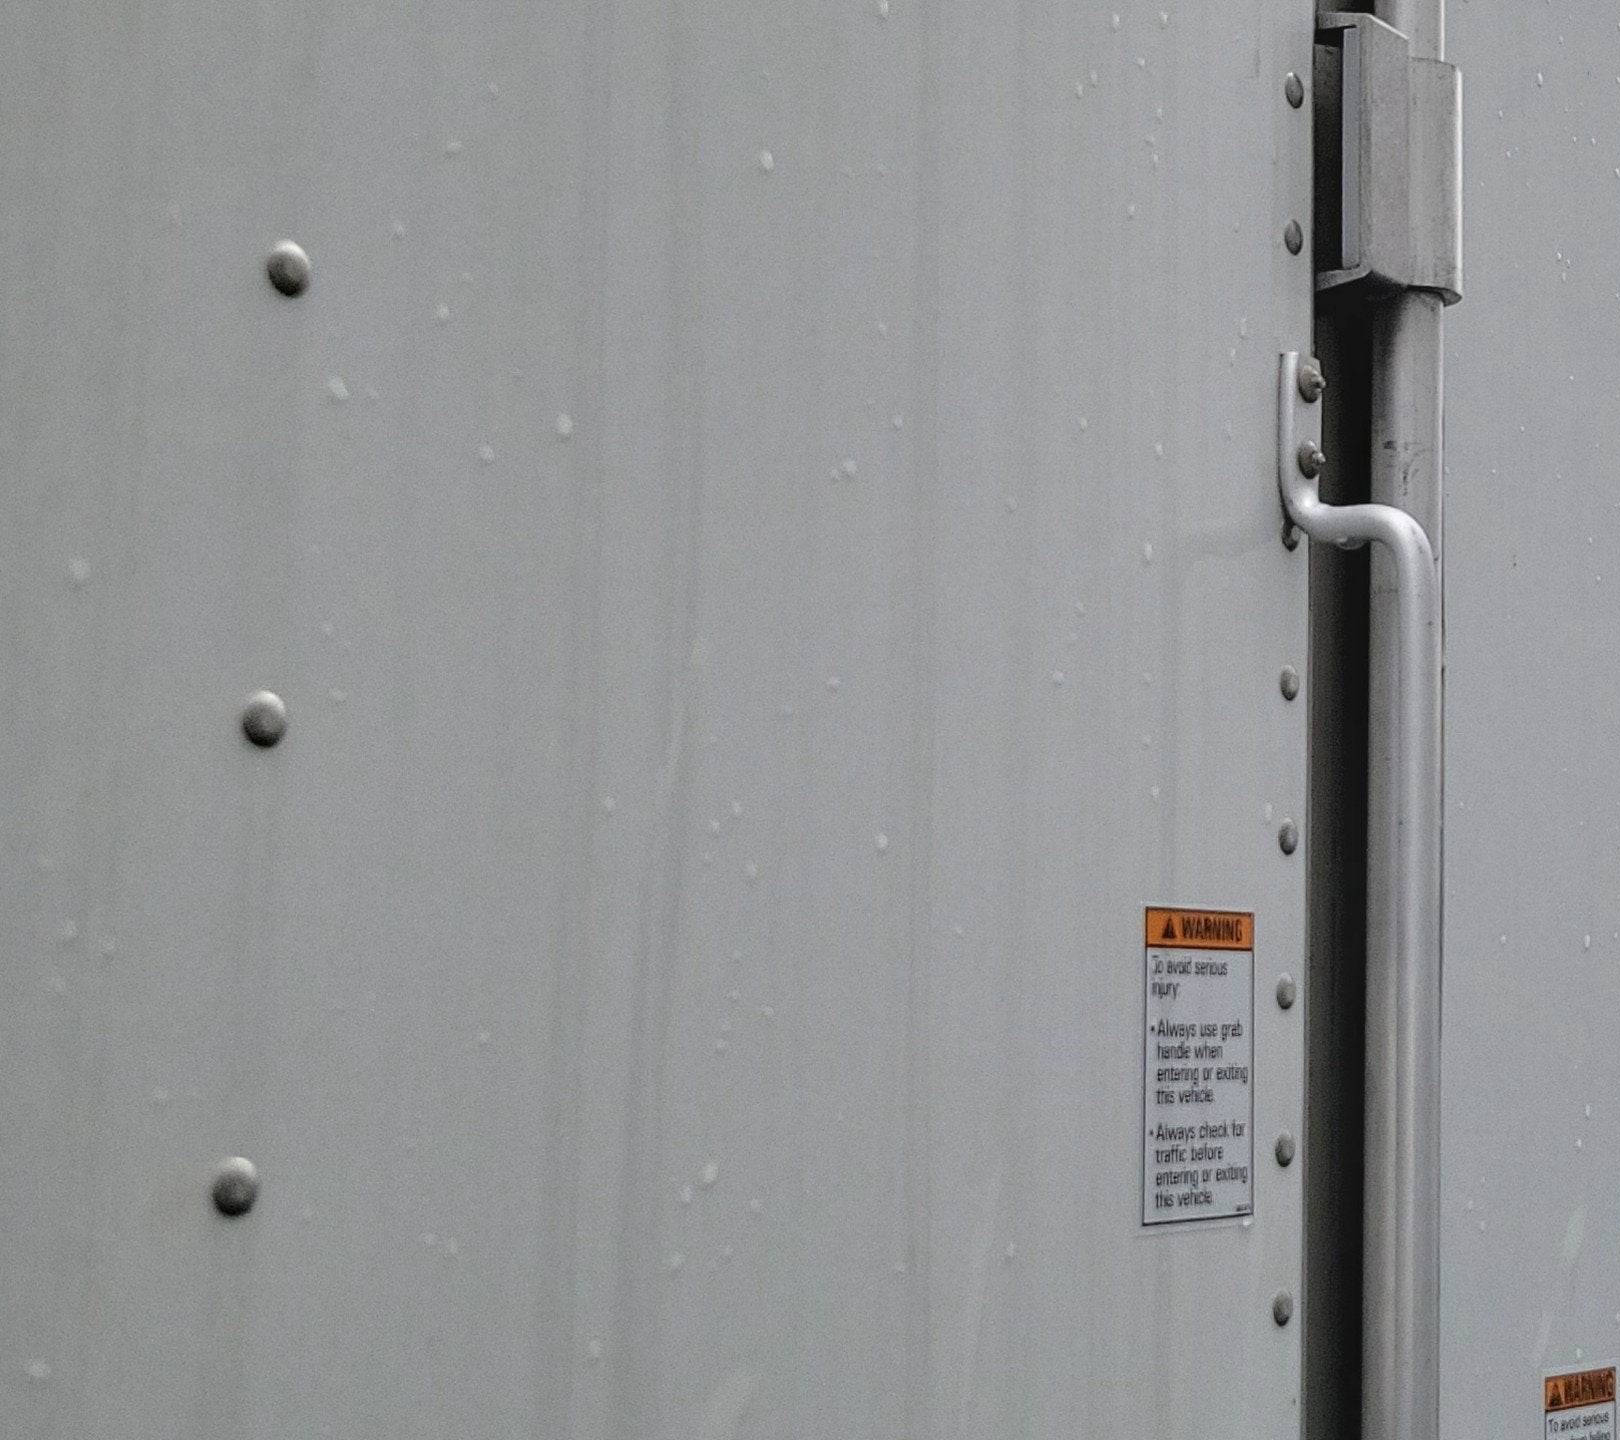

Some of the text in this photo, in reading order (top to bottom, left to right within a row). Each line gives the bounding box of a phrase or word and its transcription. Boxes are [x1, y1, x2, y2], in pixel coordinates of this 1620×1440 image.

[1182, 916, 1243, 944] WARNING
[1166, 956, 1192, 975] avoid
[1195, 958, 1228, 976] serious
[1158, 1019, 1244, 1042] Always use grab
[1158, 1042, 1223, 1060] handle when
[1158, 1063, 1249, 1087] entering or exiting
[1156, 1087, 1175, 1105] this
[1156, 1119, 1246, 1145] Always check for
[1156, 1144, 1224, 1163] traffic before
[1156, 1165, 1248, 1188] entering or exiting
[1155, 1190, 1174, 1209] this
[1548, 1412, 1610, 1433] To avoid serious
